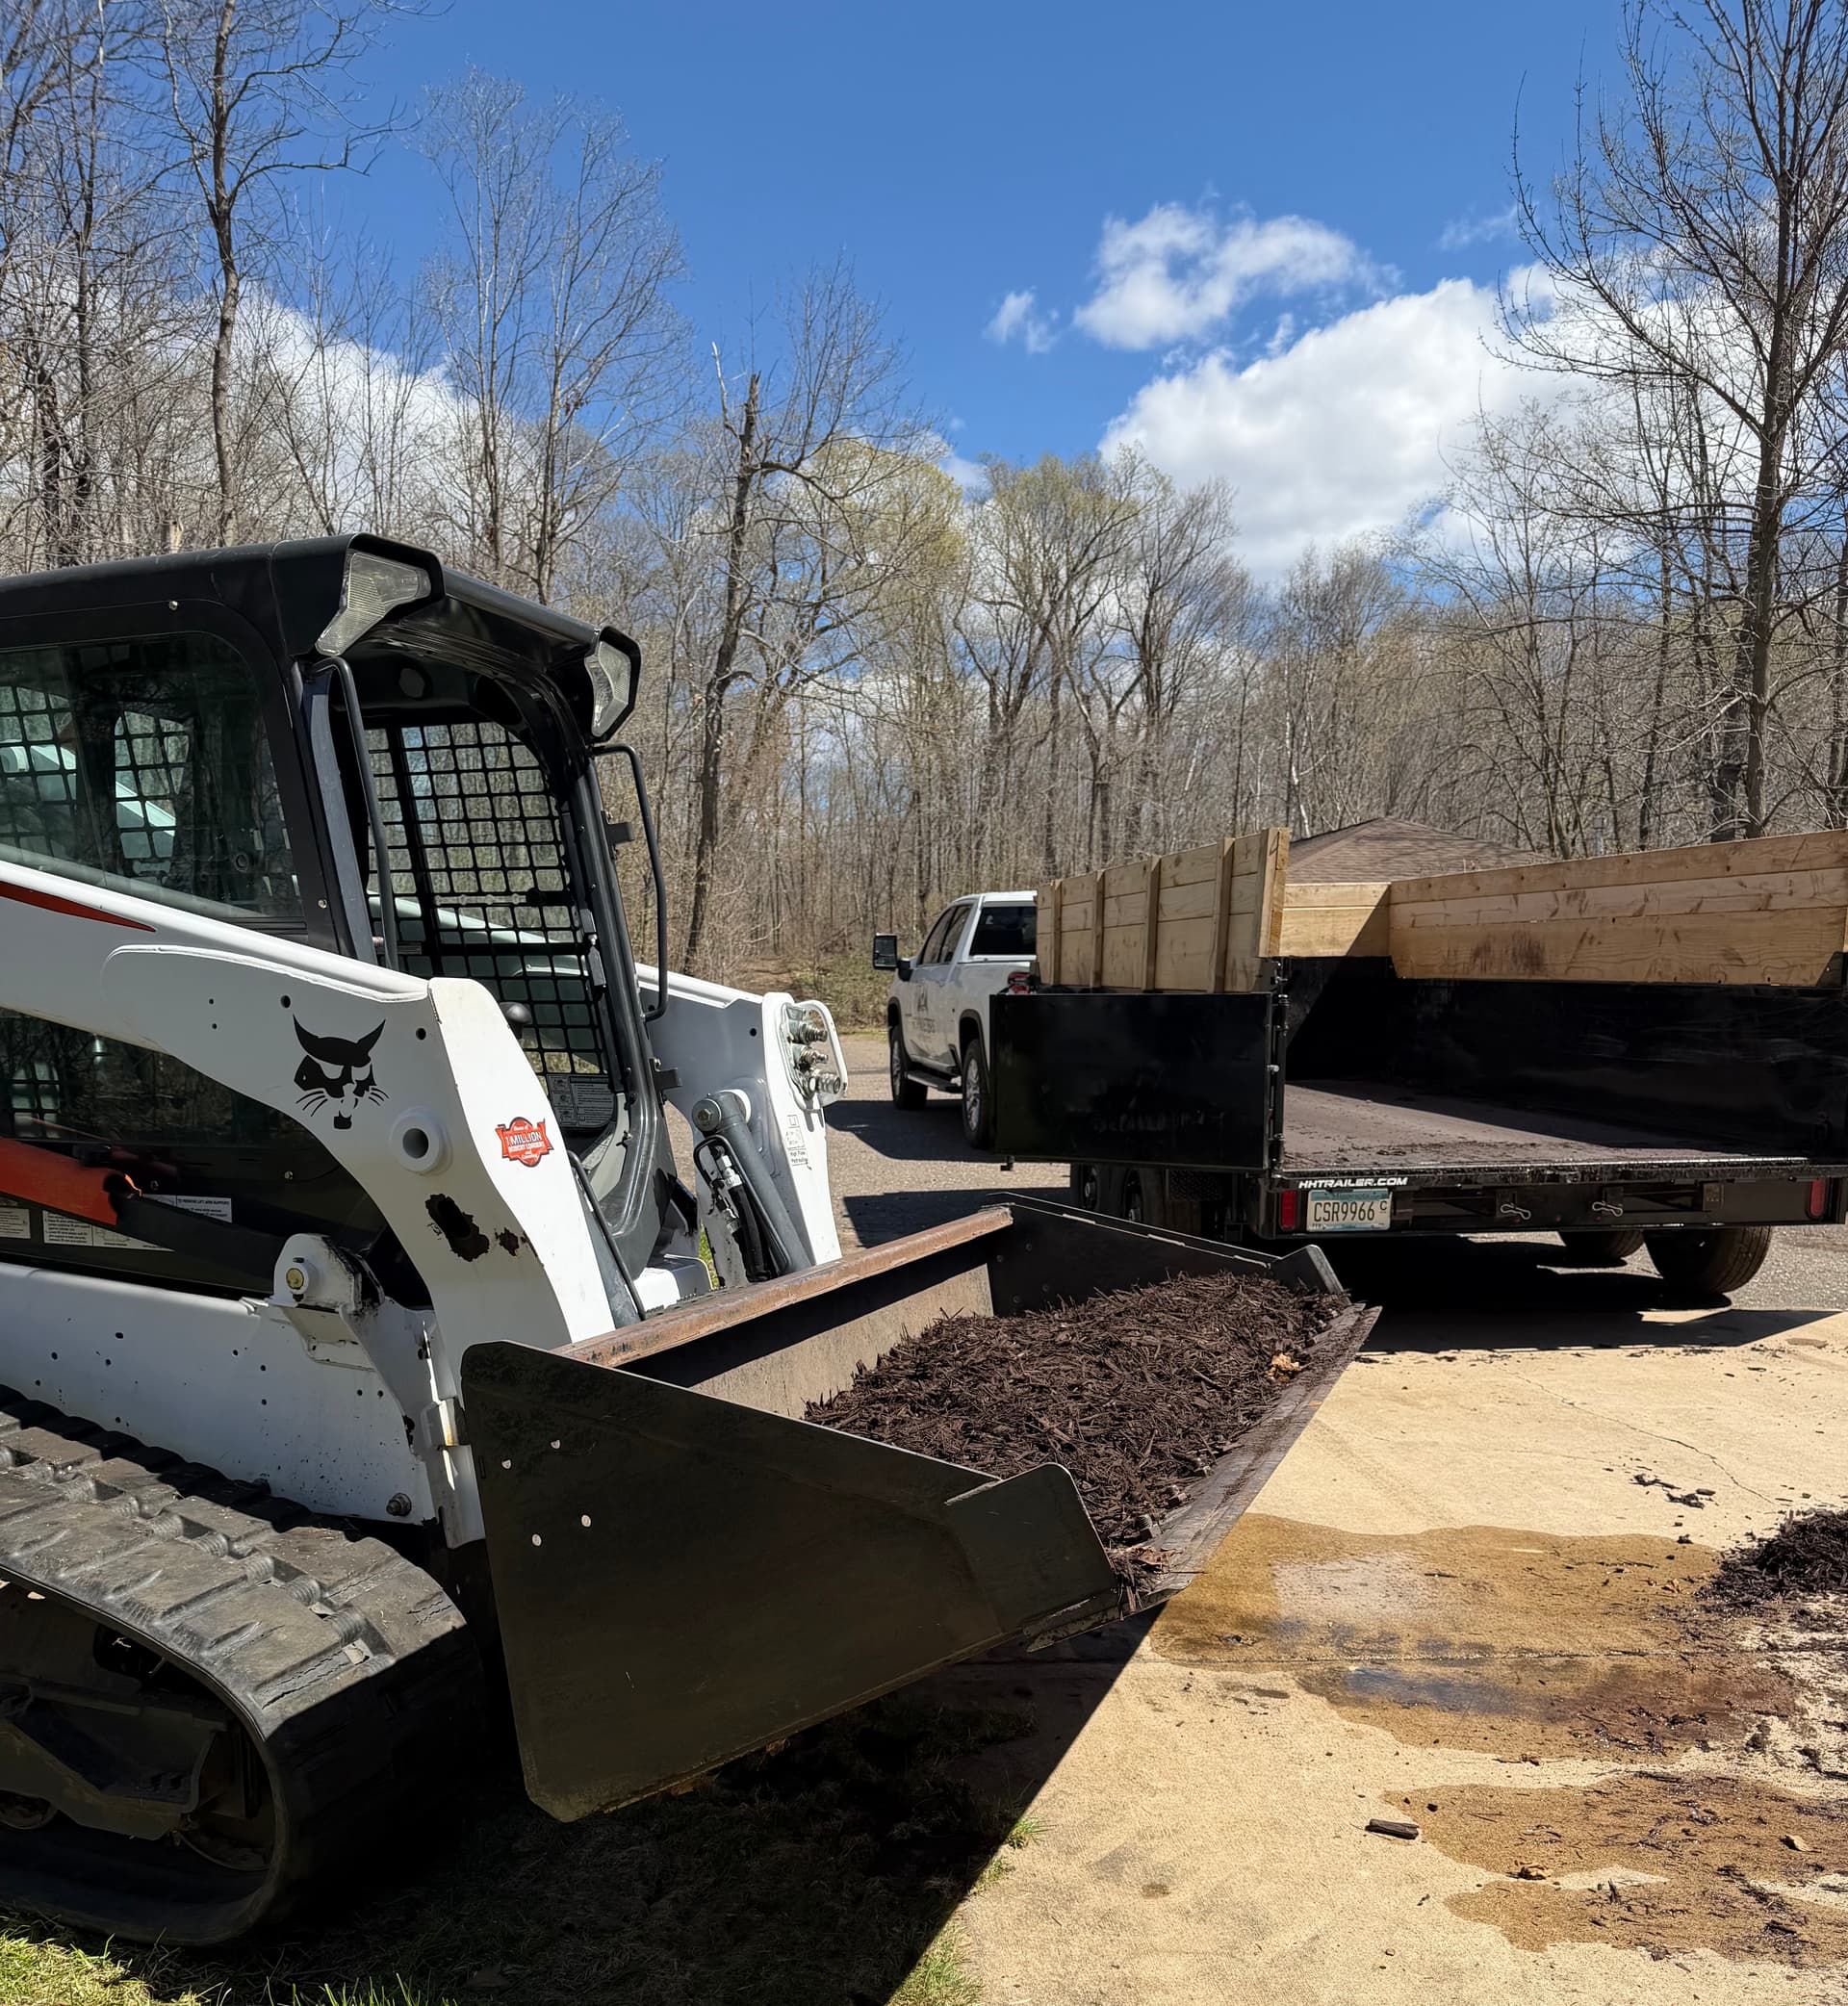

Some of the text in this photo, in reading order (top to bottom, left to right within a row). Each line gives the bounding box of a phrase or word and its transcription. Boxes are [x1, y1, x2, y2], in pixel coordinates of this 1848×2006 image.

[510, 1131, 543, 1146] MILLION
[1298, 1177, 1408, 1189] HHTRAILER.COM
[1314, 1200, 1388, 1222] CSR9966 C
